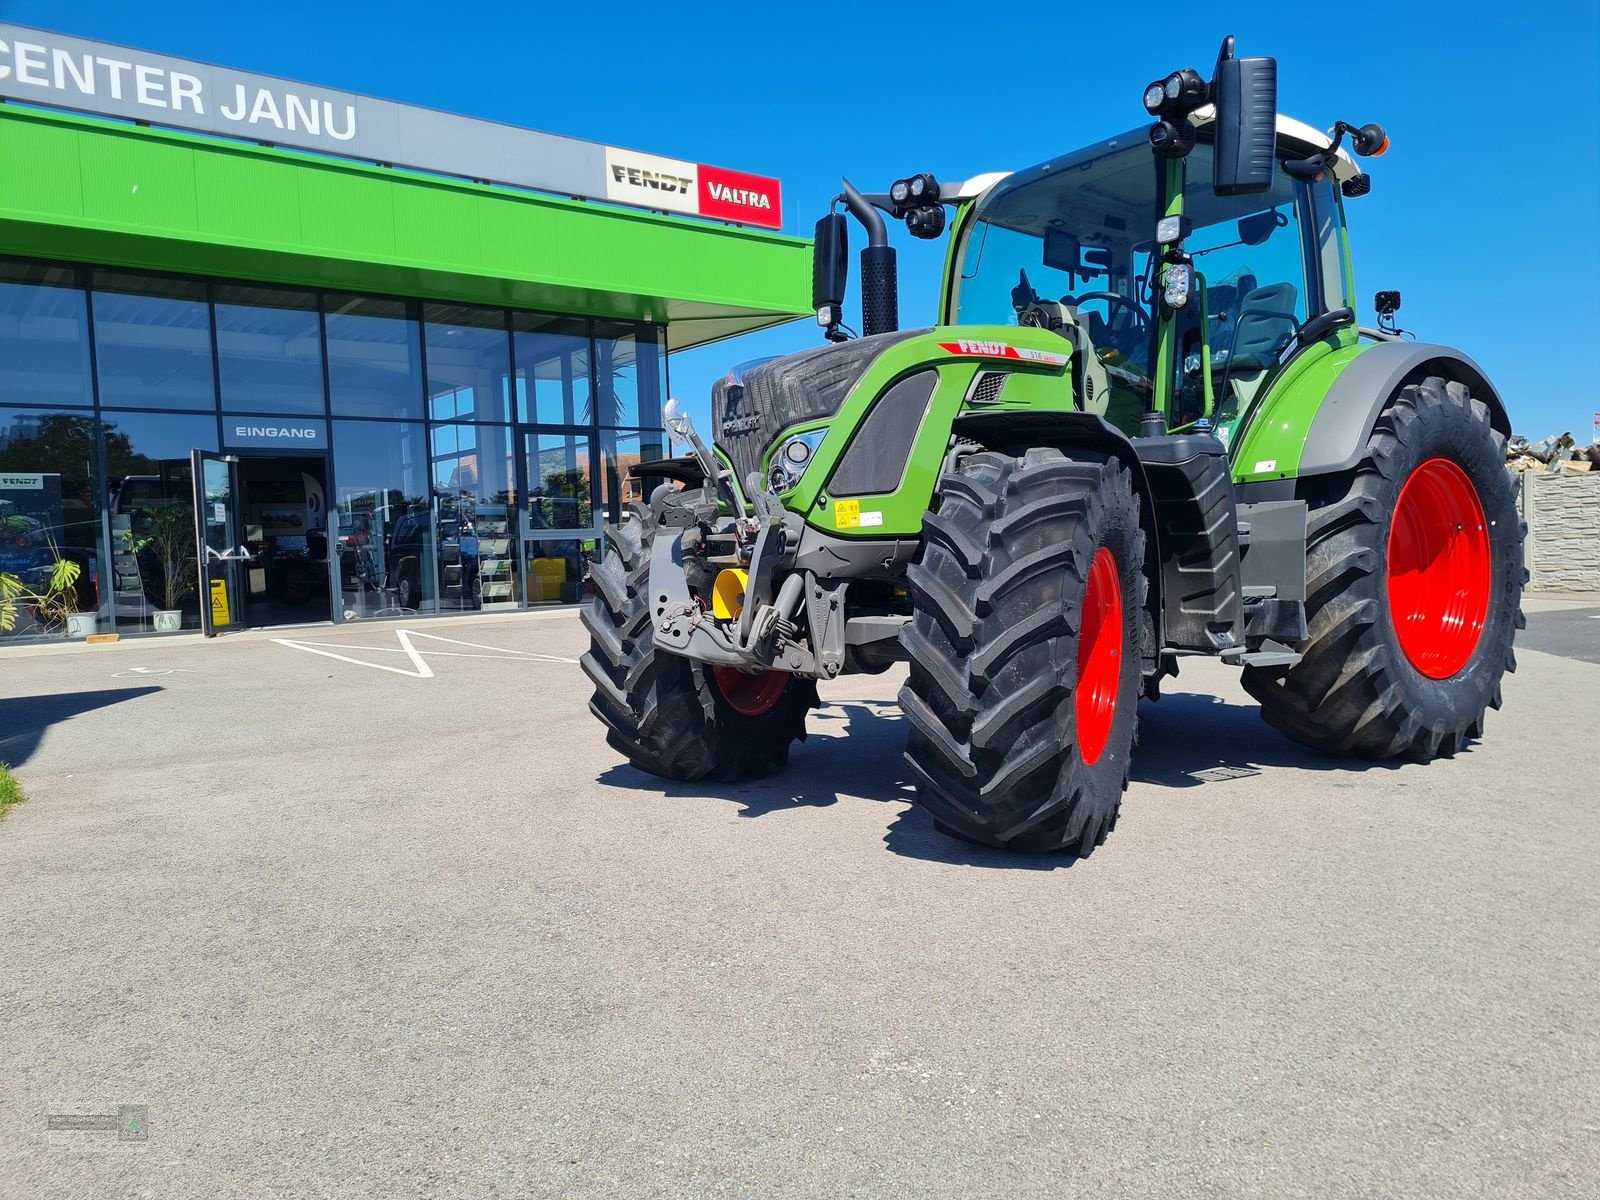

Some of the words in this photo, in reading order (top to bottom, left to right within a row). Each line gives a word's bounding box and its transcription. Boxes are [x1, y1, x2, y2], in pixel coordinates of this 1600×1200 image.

[220, 83, 357, 141] JANU
[611, 164, 693, 194] FENDT
[706, 181, 771, 210] VALTRA
[957, 339, 1008, 356] FENDT
[1030, 351, 1043, 360] 516
[235, 426, 316, 439] EINGANG
